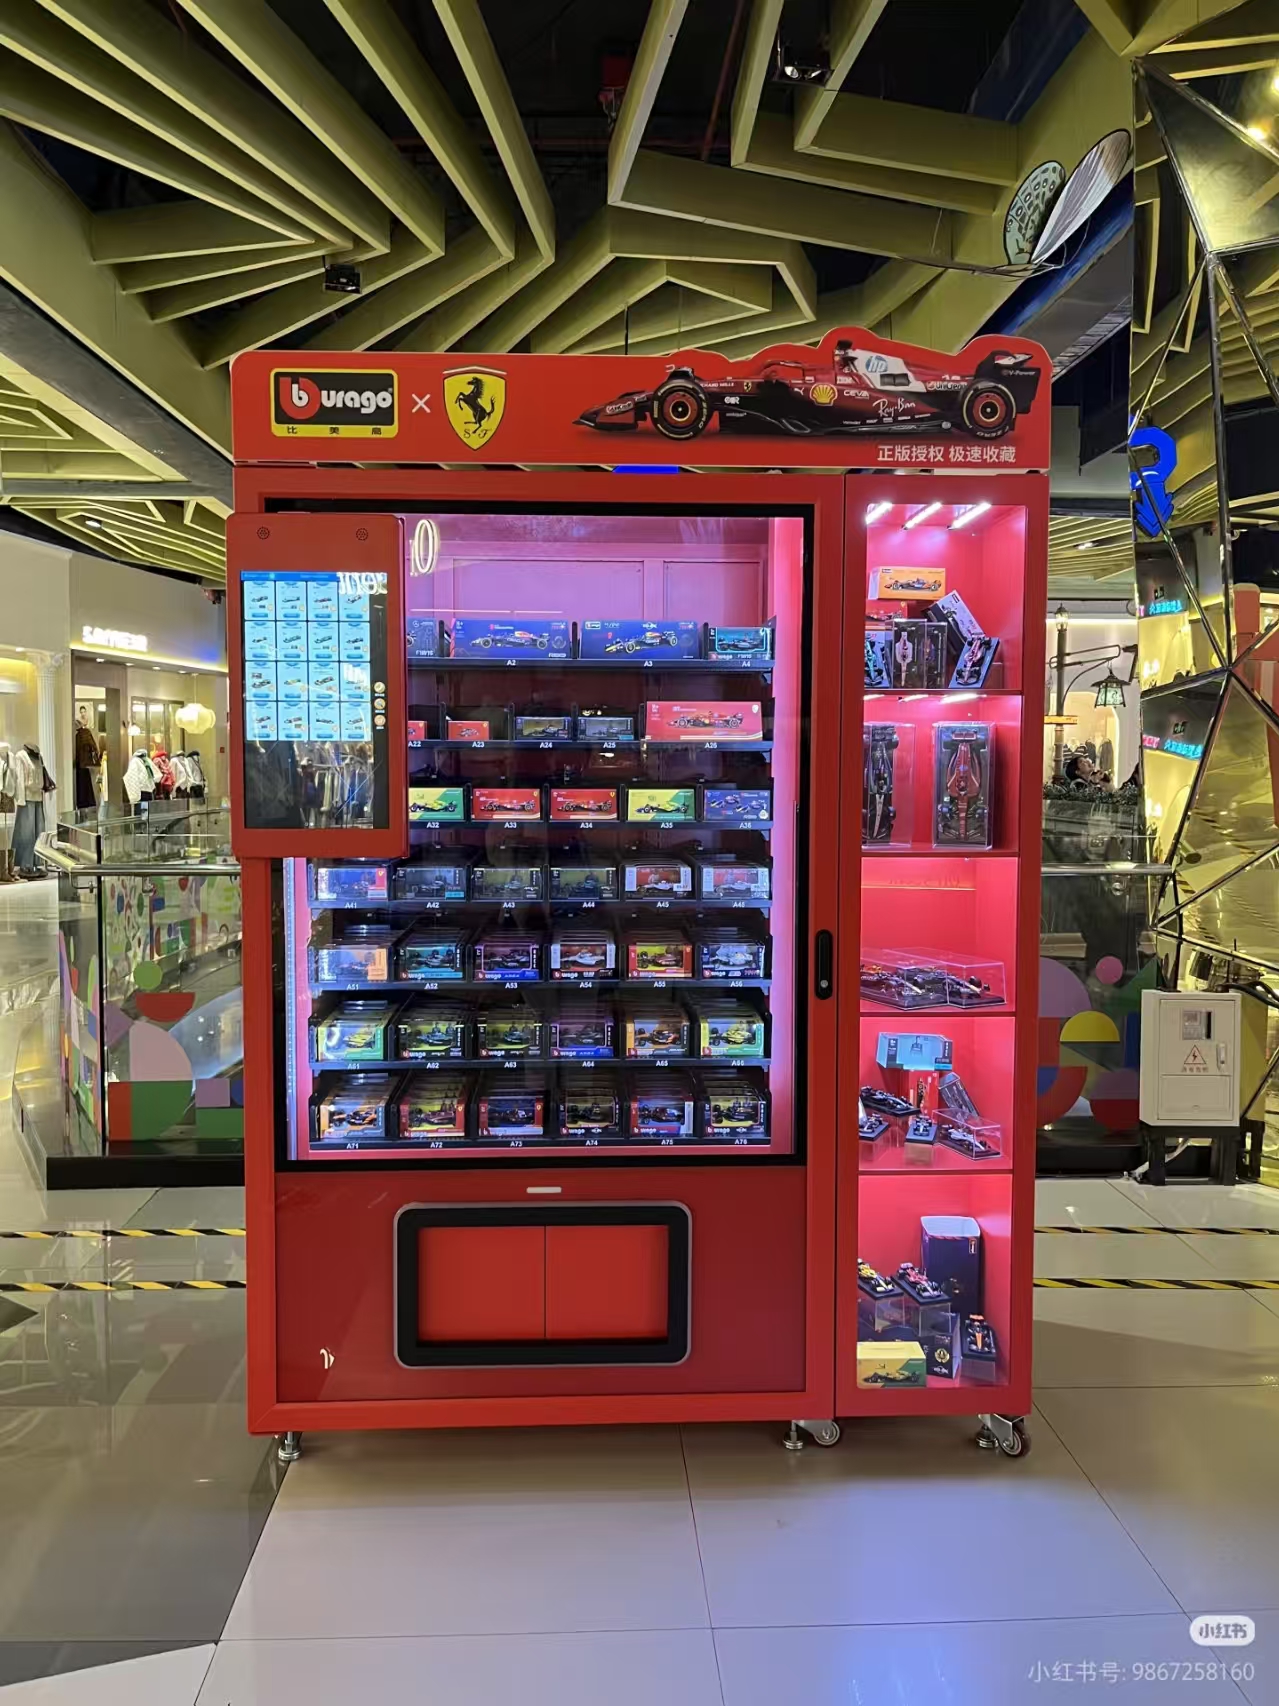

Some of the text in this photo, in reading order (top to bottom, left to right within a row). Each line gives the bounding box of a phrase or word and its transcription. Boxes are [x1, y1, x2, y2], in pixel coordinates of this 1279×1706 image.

[878, 445, 1016, 463] 正版授权 极速收藏
